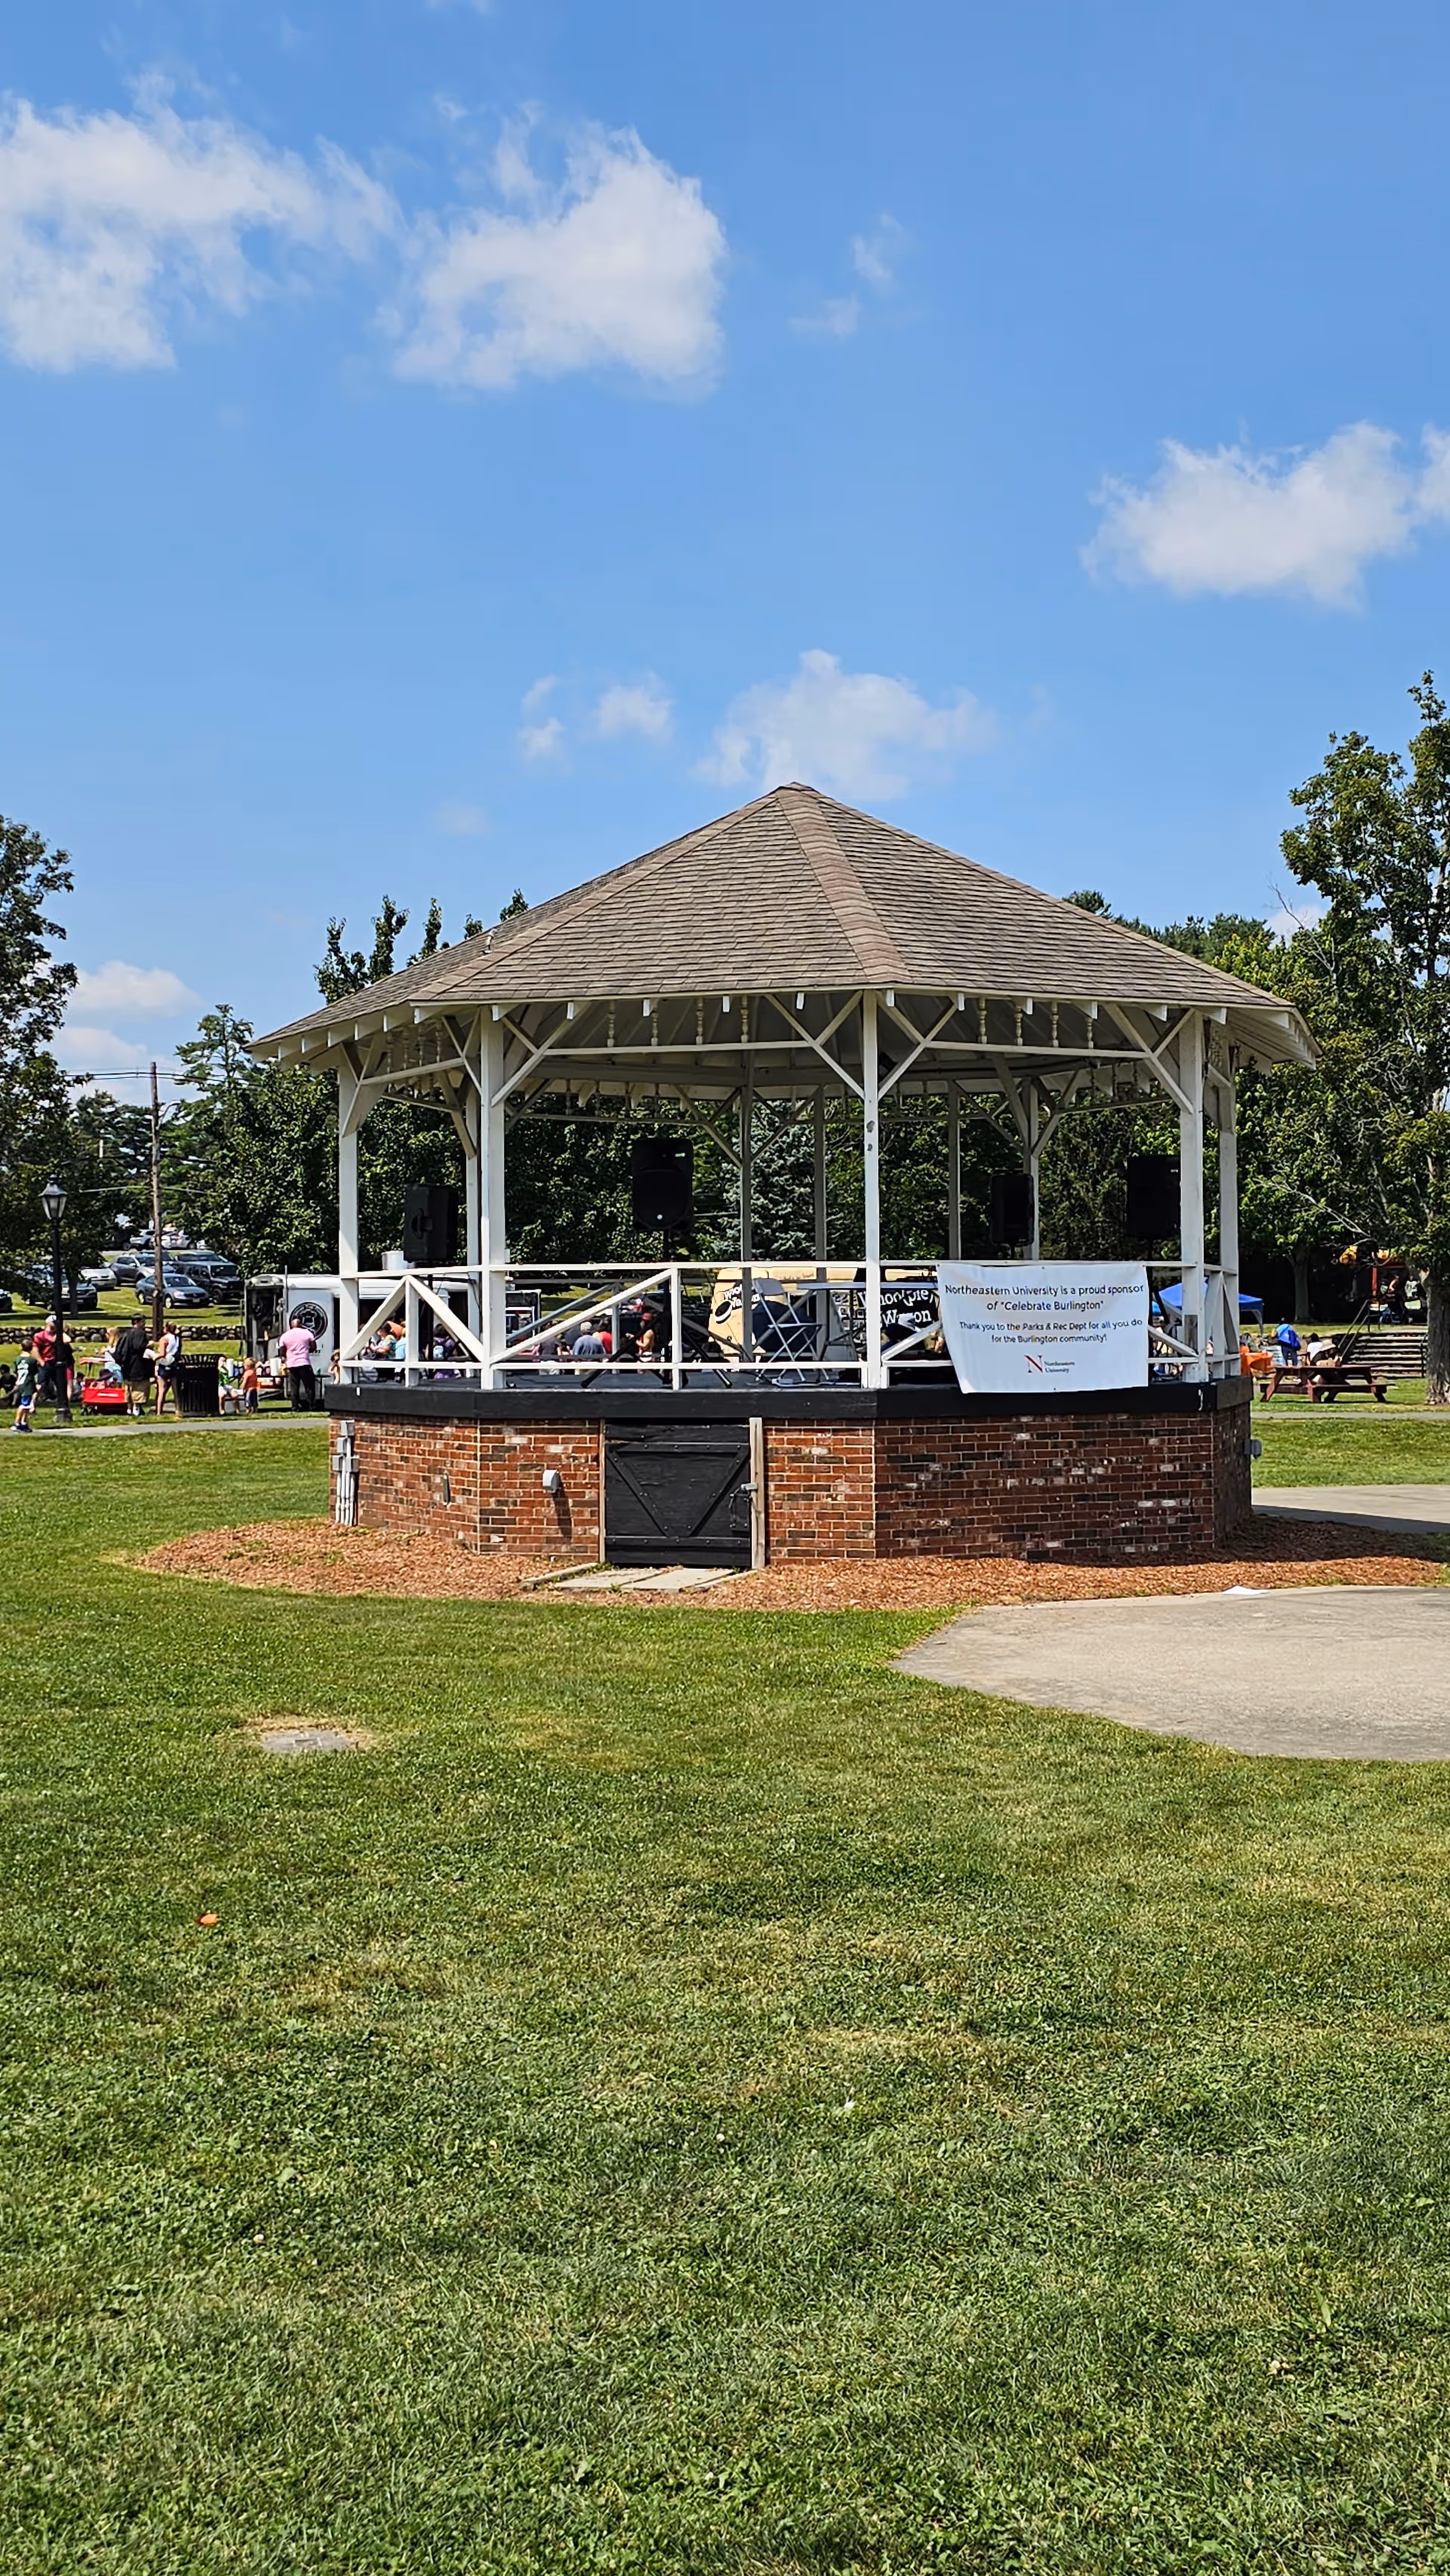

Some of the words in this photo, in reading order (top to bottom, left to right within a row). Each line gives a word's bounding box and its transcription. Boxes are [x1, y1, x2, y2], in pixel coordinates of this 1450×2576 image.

[944, 1284, 1010, 1295] Northeastern
[1012, 1285, 1059, 1297] University
[1060, 1285, 1068, 1295] is
[1078, 1284, 1106, 1297] proud
[1108, 1285, 1144, 1296] sponsor
[986, 1300, 998, 1311] of
[958, 1321, 980, 1330] Thank
[980, 1324, 995, 1333] you
[997, 1323, 1005, 1331] to
[1007, 1322, 1020, 1331] the
[1022, 1322, 1044, 1331] Parks
[1046, 1322, 1052, 1330] &
[1053, 1322, 1067, 1330] Rec
[1069, 1322, 1087, 1331] Dept
[1088, 1320, 1099, 1329] for
[992, 1335, 1002, 1343] for
[1004, 1335, 1016, 1343] the
[1017, 1335, 1058, 1345] Burlington
[1060, 1333, 1108, 1343] community!
